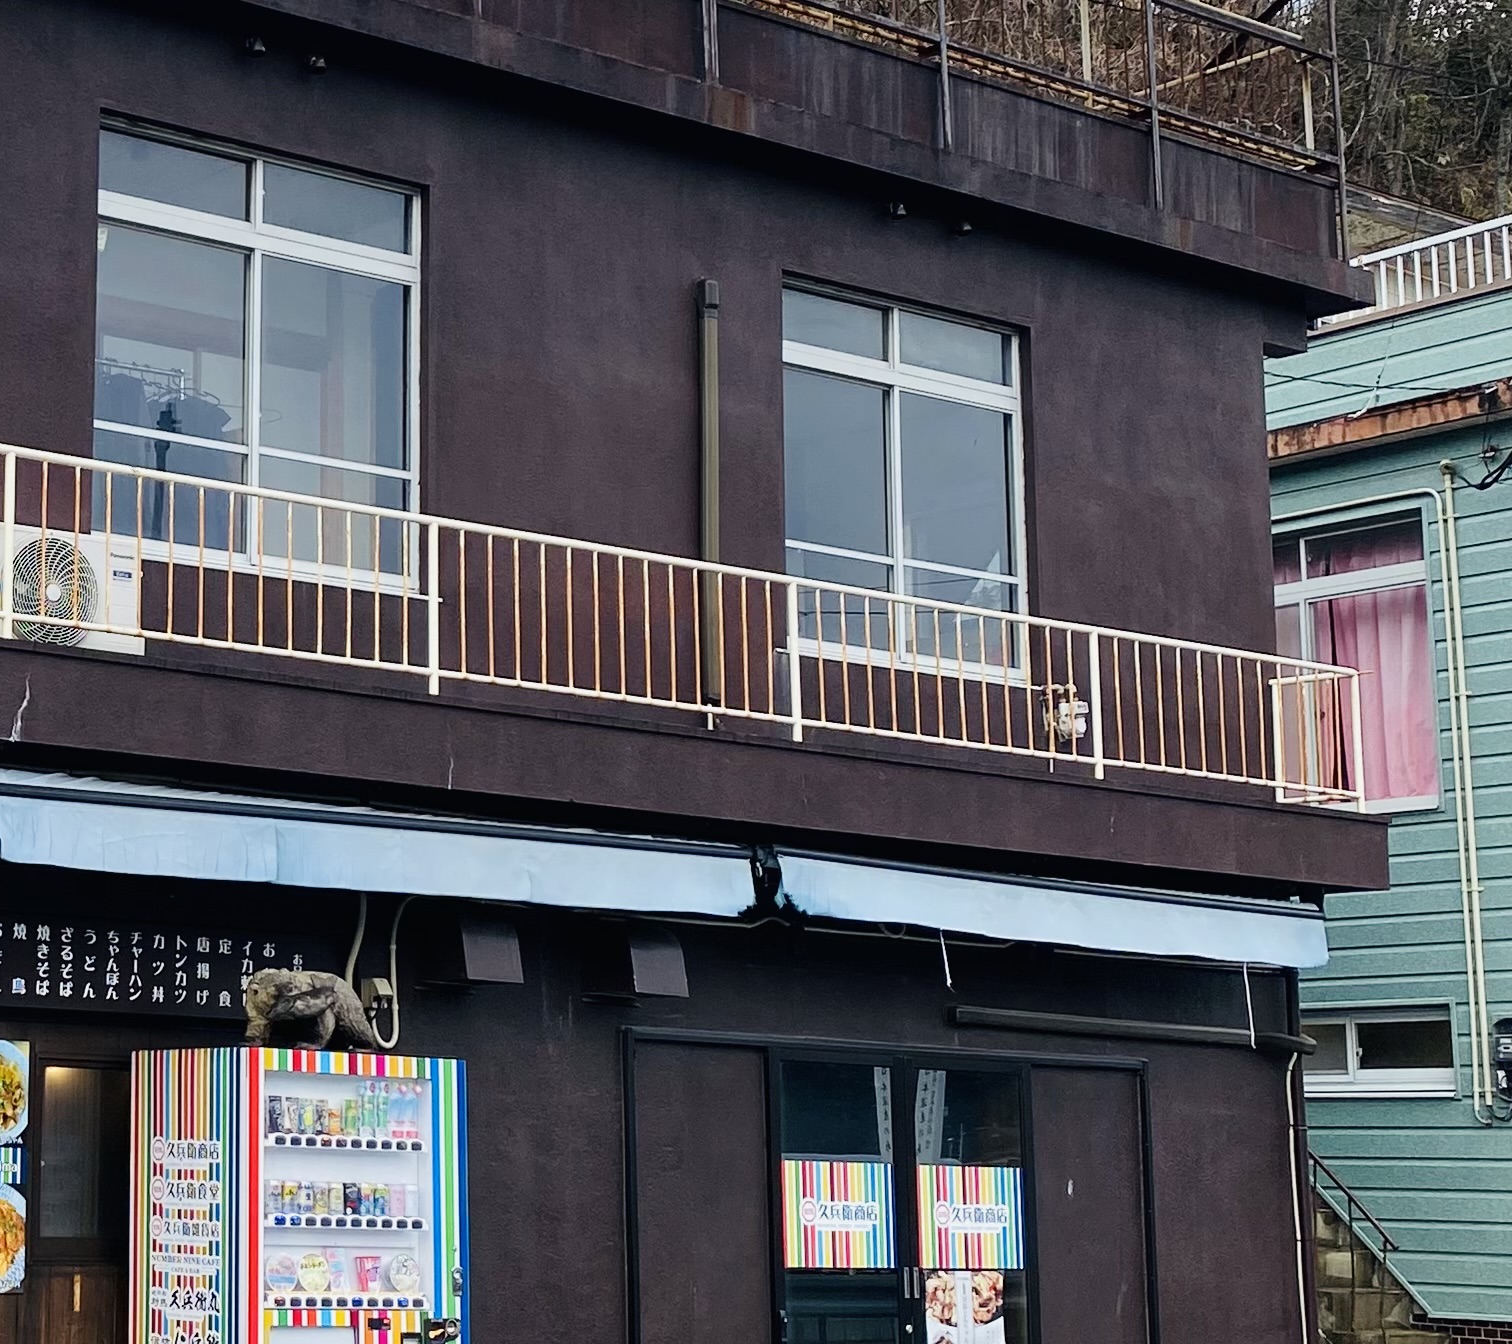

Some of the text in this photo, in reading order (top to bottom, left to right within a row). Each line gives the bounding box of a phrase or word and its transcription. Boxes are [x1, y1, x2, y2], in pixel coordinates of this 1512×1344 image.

[36, 924, 51, 996] 焼きそば
[59, 927, 75, 997] ざるそば
[83, 929, 97, 999] うどん
[105, 930, 120, 1001] ちゃんぽん
[128, 931, 143, 1002] チャーハン
[152, 934, 165, 1003] カツ丼
[174, 935, 188, 1005] トンカツ
[196, 936, 210, 1005] 唐揚げ
[218, 938, 233, 1008] 定食
[167, 1142, 220, 1160] 久兵衛商店
[166, 1182, 220, 1201] 久兵衛食堂
[818, 1203, 878, 1221] 久兵衛商店
[951, 1207, 1007, 1224] 久兵衛商店
[151, 1254, 182, 1263] NUMBER
[183, 1256, 201, 1265] NINE
[163, 1220, 220, 1238] 久兵衛雑貨店
